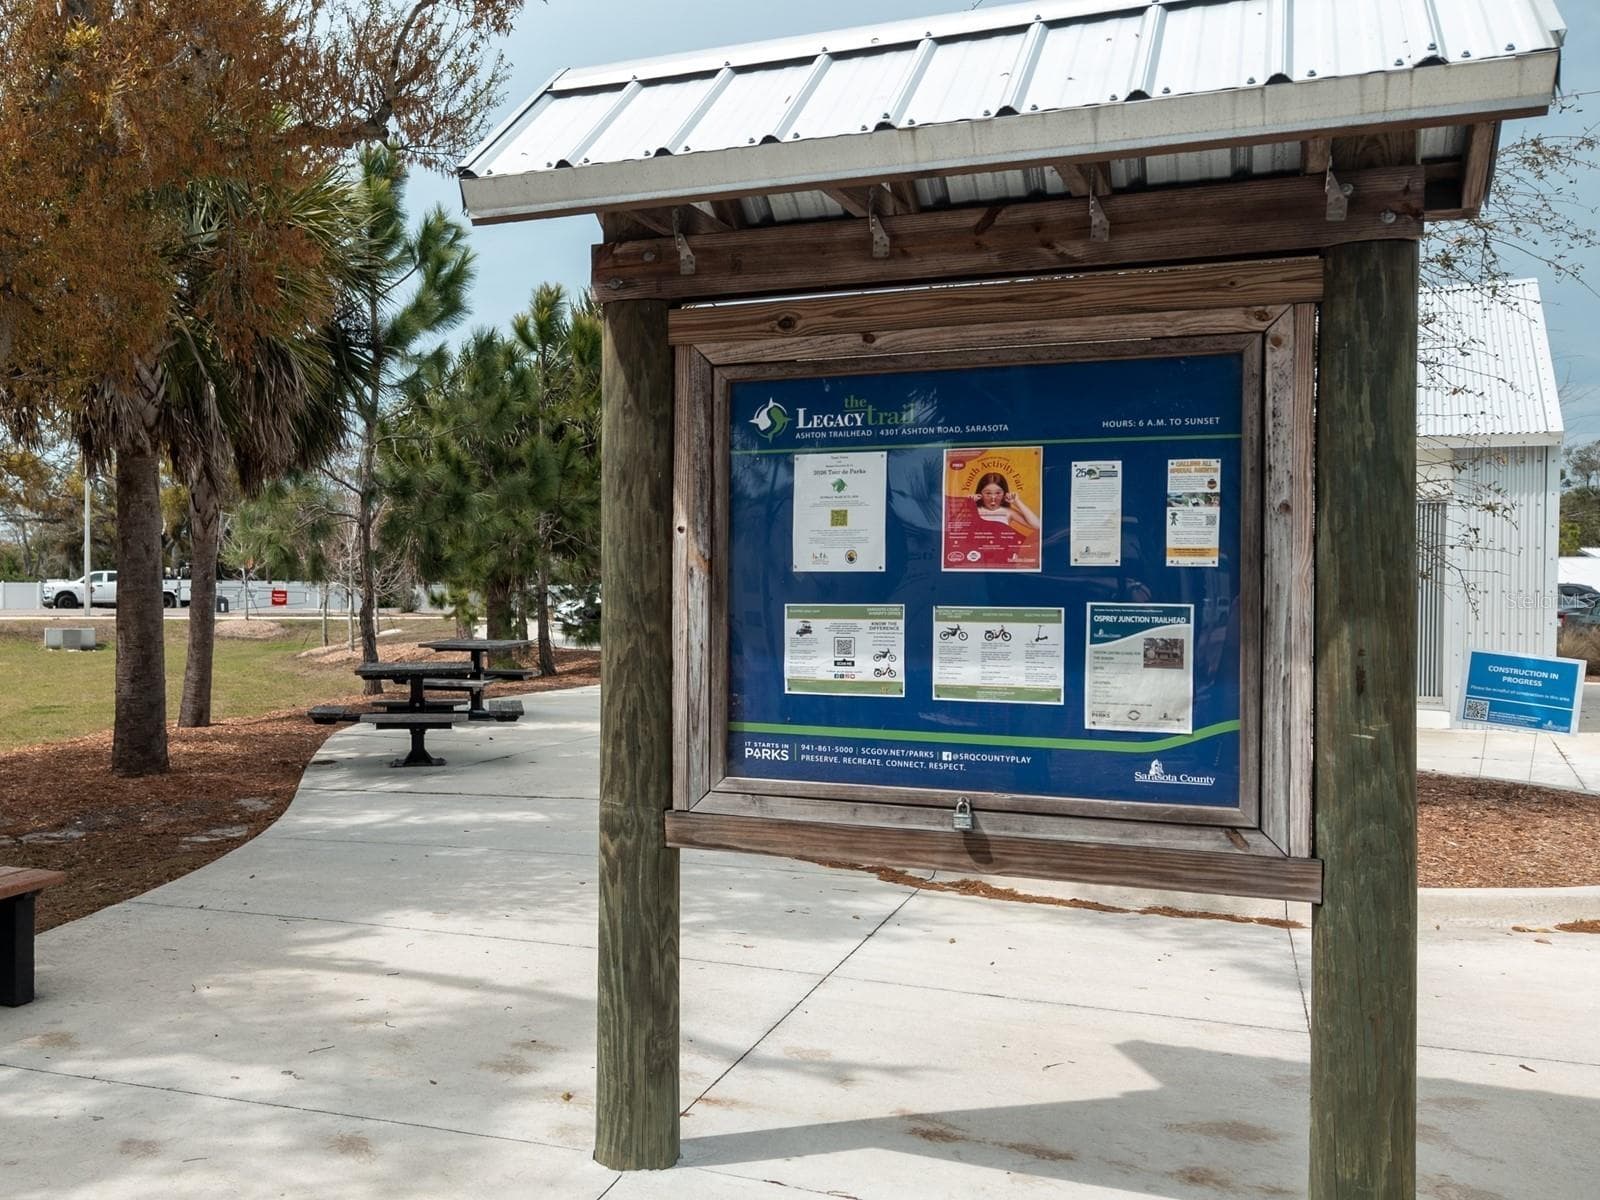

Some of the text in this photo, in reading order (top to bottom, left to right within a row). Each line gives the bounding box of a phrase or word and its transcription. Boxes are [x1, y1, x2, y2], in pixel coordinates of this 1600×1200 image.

[844, 395, 867, 408] the
[1102, 416, 1220, 428] HOURS: 6 A.M. TO SUNSET
[795, 424, 1009, 439] ASHTON TRAILHEAD 4301 ASHTON ROAD, SARASOTA
[961, 459, 1025, 491] Youth Activity Fair
[1093, 615, 1186, 624] OSPREY JUNCTION TRAILHEAD
[1488, 665, 1548, 679] CONSTRUCTION
[1502, 676, 1543, 687] PROGRESS
[744, 748, 789, 761] PARKS
[800, 744, 1032, 764] 941-861-5000 SCGOV.NET/PARKS @SRQCOUNTYPLAY
[800, 754, 967, 771] PRESERVE. RECREATE. CONNECT. RESPECT.
[1180, 774, 1216, 785] County
